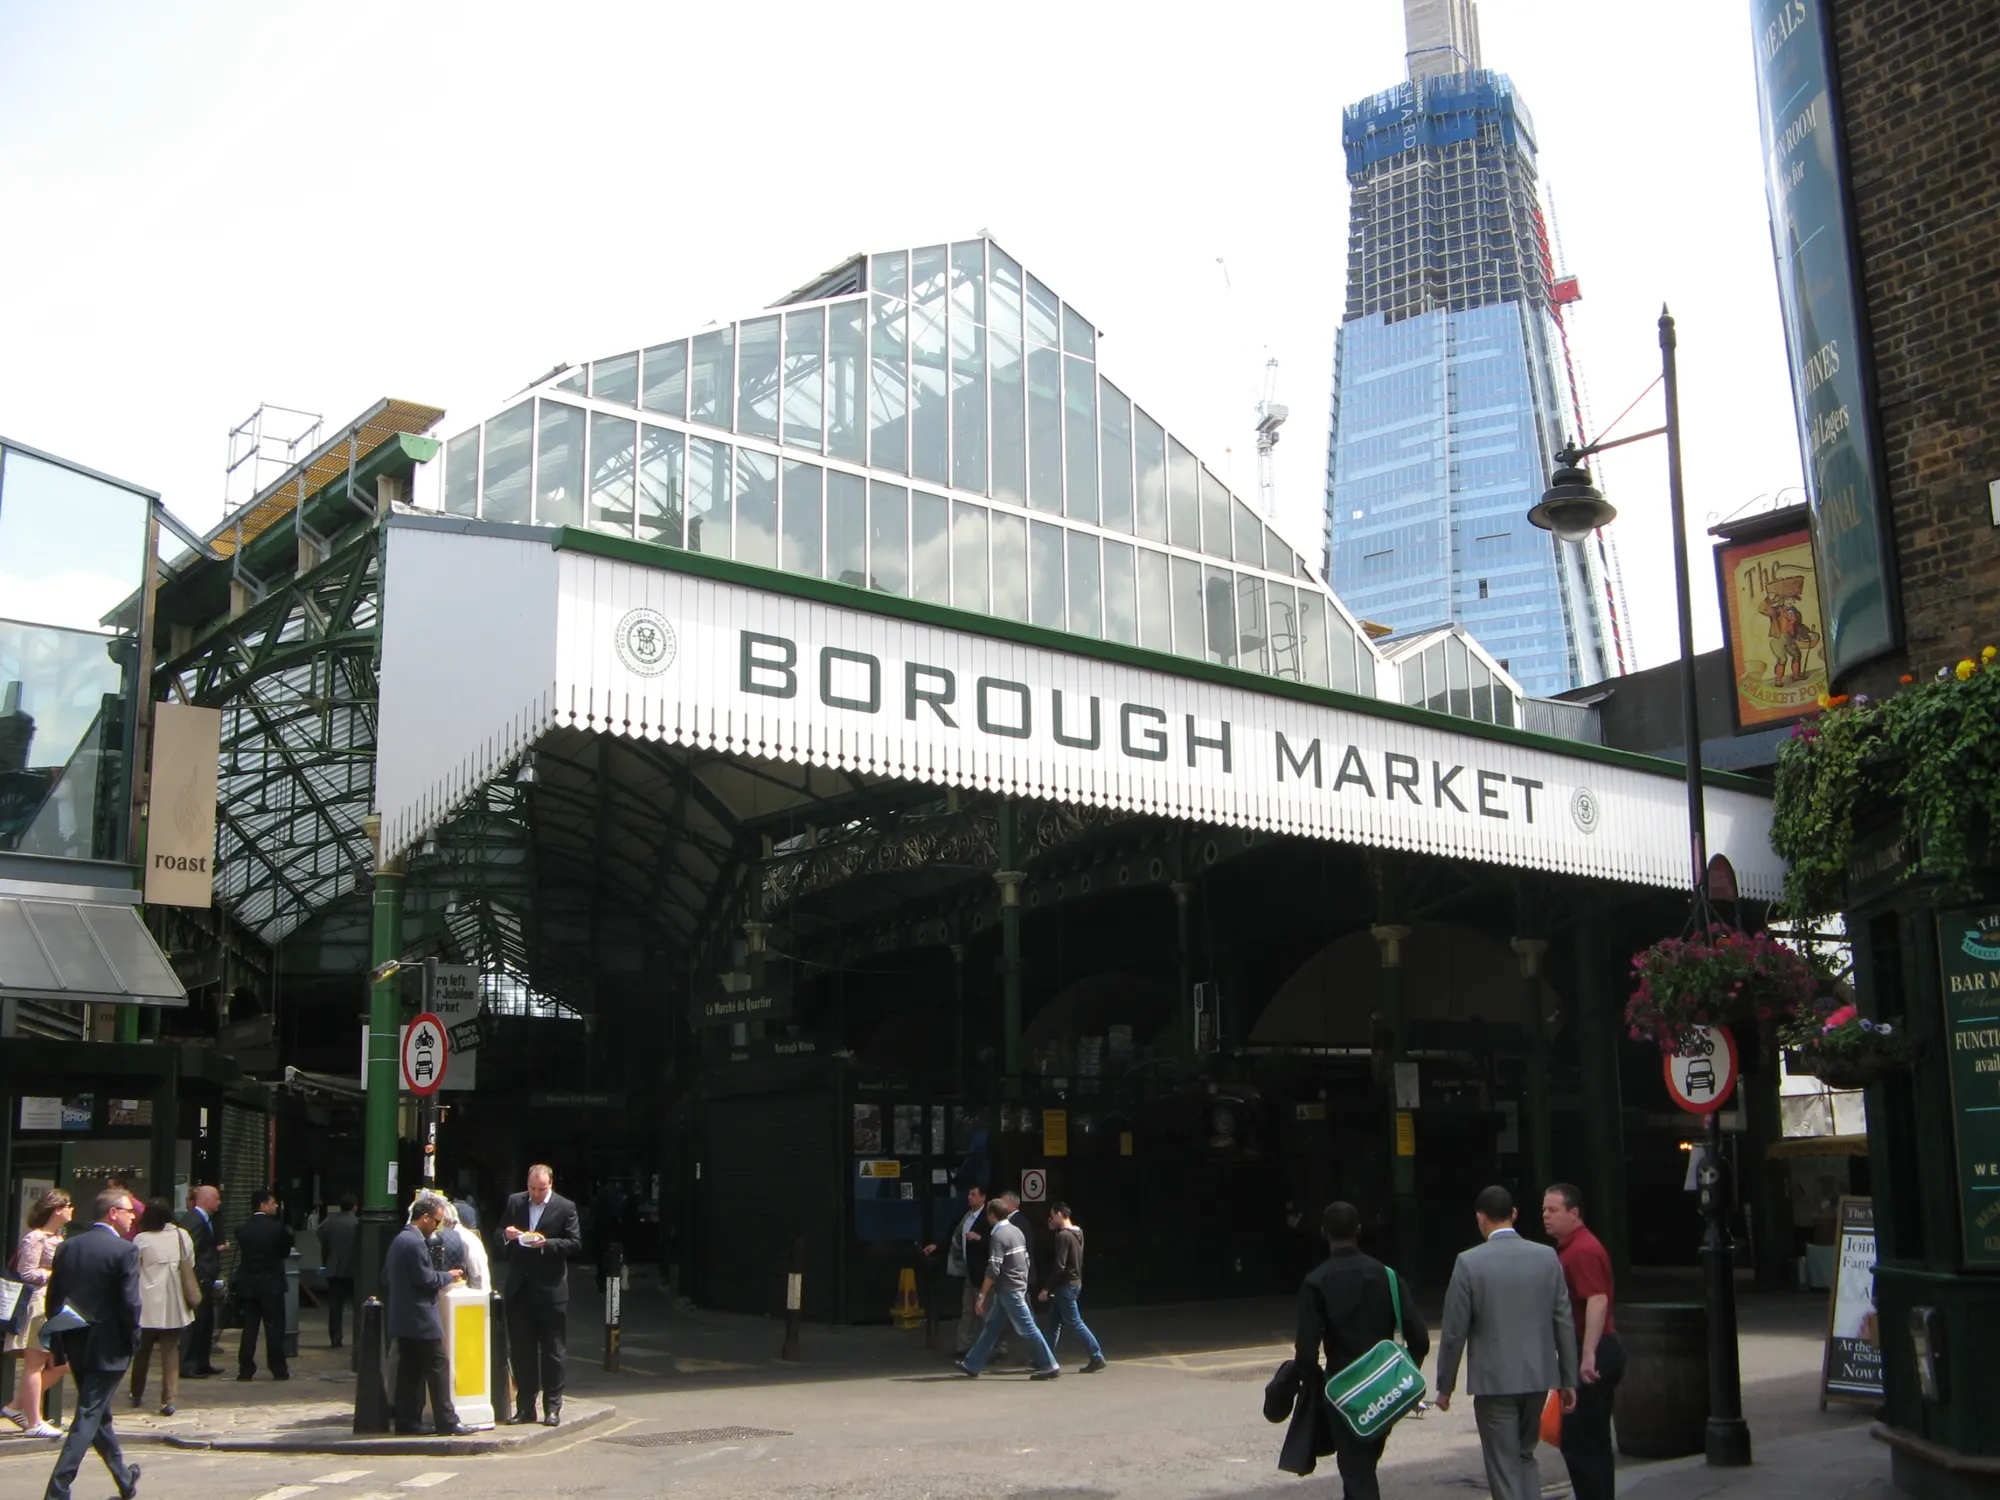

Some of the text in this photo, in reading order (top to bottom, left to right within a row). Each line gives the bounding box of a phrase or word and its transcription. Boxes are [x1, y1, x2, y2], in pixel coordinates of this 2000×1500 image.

[1400, 80, 1417, 149] SHARD
[1785, 103, 1817, 153] ROOM
[1791, 160, 1805, 187] for
[1818, 404, 1850, 446] Lagers
[1745, 683, 1796, 704] MARKET
[740, 629, 1544, 824] BOROUGH MARKET
[155, 854, 207, 873] roast
[450, 974, 465, 986] left
[1950, 972, 1986, 993] BAR
[442, 987, 474, 1000] Jubilee
[1955, 1029, 2000, 1051] FUNCTI
[1030, 1179, 1037, 1191] 5
[1847, 1207, 1866, 1219] The
[1844, 1236, 1876, 1254] Join
[1838, 1339, 1853, 1351] At
[1855, 1341, 1872, 1353] the
[1842, 1362, 1875, 1380] Now
[1358, 1387, 1402, 1425] adidas
